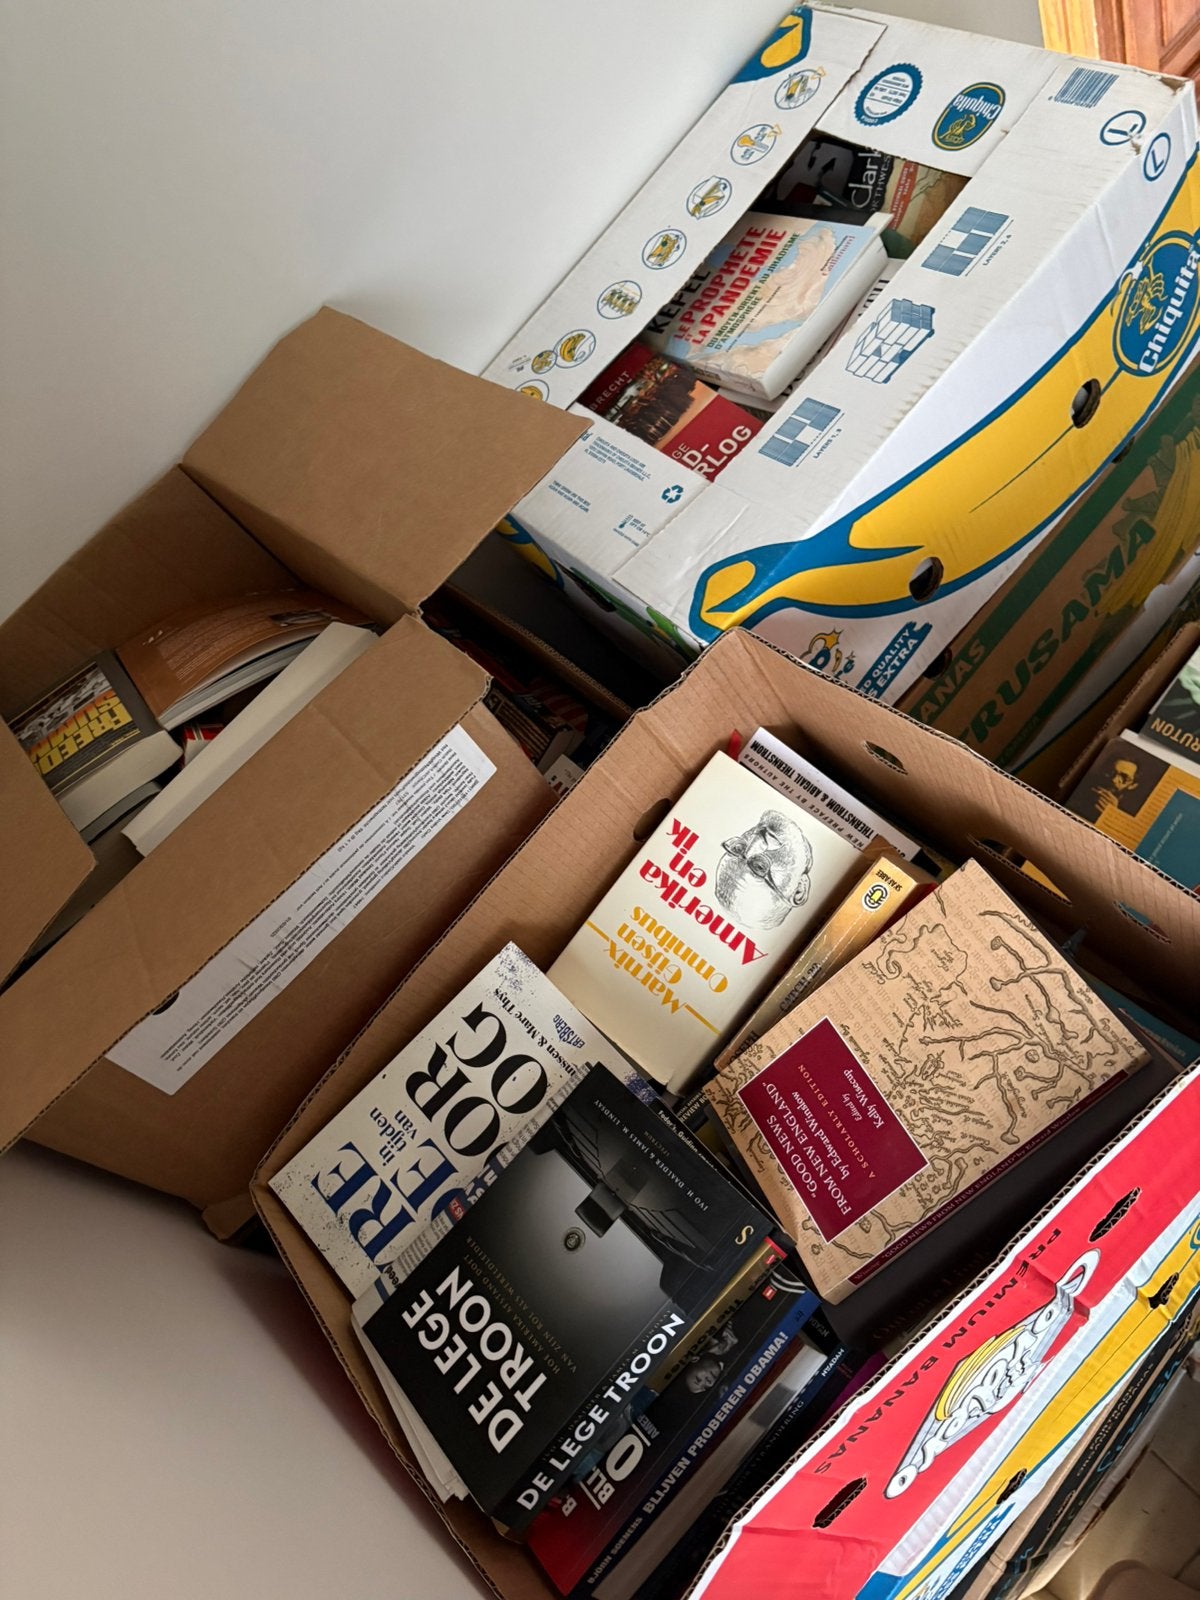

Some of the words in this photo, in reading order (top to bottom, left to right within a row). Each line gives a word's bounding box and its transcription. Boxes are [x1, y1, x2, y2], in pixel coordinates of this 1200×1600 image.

[952, 94, 1001, 121] Chiquita
[981, 242, 1002, 267] LAYERS
[644, 268, 716, 335] KEPEL
[705, 336, 719, 348] DU
[714, 283, 761, 337] MOYEN-ORIENT
[756, 272, 771, 284] AU
[766, 232, 801, 272] JIHADISME
[1138, 244, 1200, 373] Chiquita
[671, 324, 691, 339] LE
[690, 327, 711, 345] LA
[669, 441, 691, 460] GE
[811, 436, 832, 459] LAYERS
[960, 517, 1157, 745] RUSAMA
[872, 629, 910, 678] QUALITY
[876, 638, 919, 688] EXTRA
[33, 702, 133, 778] FREED
[746, 736, 797, 779] THERNSTROM
[740, 749, 778, 782] AUTHORS
[777, 778, 795, 794] THE
[791, 772, 823, 799] ABIGAIL
[794, 792, 808, 805] BY
[818, 792, 830, 804] &
[659, 816, 700, 856] ik
[806, 802, 845, 833] PREFACE
[825, 797, 876, 839] THERNSTROM
[843, 831, 865, 848] NEW
[665, 849, 710, 892] en
[633, 857, 769, 974] Amerika
[612, 920, 686, 988] Gijsen
[626, 900, 732, 998] Omnibus
[599, 938, 688, 1018] Marnix
[490, 981, 523, 1016] Thys
[511, 1008, 542, 1040] Marc
[532, 1032, 550, 1049] &
[545, 1011, 587, 1054] ERTSBERG
[796, 1062, 829, 1108] EDITION
[839, 1065, 872, 1107] Wisecup
[839, 1090, 852, 1104] by
[364, 1102, 412, 1155] tijden
[390, 1107, 420, 1141] van
[591, 1096, 623, 1127] LINDSAY
[617, 1121, 631, 1135] M.
[761, 1076, 808, 1145] ENGLAND”
[788, 1088, 820, 1132] Winslow
[845, 1099, 863, 1123] Edited
[863, 1100, 887, 1129] Kelly
[626, 1129, 652, 1155] JAMES
[765, 1113, 795, 1155] NEWS
[813, 1127, 842, 1167] Edward
[826, 1107, 869, 1169] SCHOLARLY
[373, 1143, 396, 1166] in
[645, 1149, 657, 1161] &
[652, 1155, 687, 1190] DAALDER
[802, 1141, 829, 1178] NEW
[835, 1160, 853, 1180] by
[681, 1184, 696, 1199] H.
[788, 1151, 822, 1198] “GOOD
[866, 1169, 876, 1180] A
[691, 1193, 710, 1213] IVO
[822, 1174, 852, 1216] FROM
[929, 1199, 956, 1222] FROM
[952, 1184, 976, 1204] NEW
[735, 1224, 755, 1247] S
[461, 1251, 483, 1277] DOET
[464, 1232, 517, 1296] WERELDLEIDER
[478, 1273, 514, 1316] AFSTAND
[512, 1292, 530, 1313] ALS
[943, 1227, 1064, 1352] PREMIUM
[432, 1262, 555, 1413] TROON
[509, 1311, 545, 1354] AMERIKA
[526, 1309, 545, 1331] ROL
[398, 1287, 484, 1395] LEGE
[541, 1327, 563, 1354] ZIJN
[540, 1349, 562, 1375] HOE
[559, 1350, 579, 1374] VAN
[464, 1378, 527, 1455] DE
[513, 1468, 557, 1513] DE
[548, 1402, 610, 1473] LEGE
[602, 1311, 686, 1407] TROON
[641, 1453, 692, 1517] BLIJVEN
[686, 1382, 748, 1460] PROBEREN
[742, 1328, 789, 1388] OBAMA!
[813, 1355, 940, 1475] BANANAS
